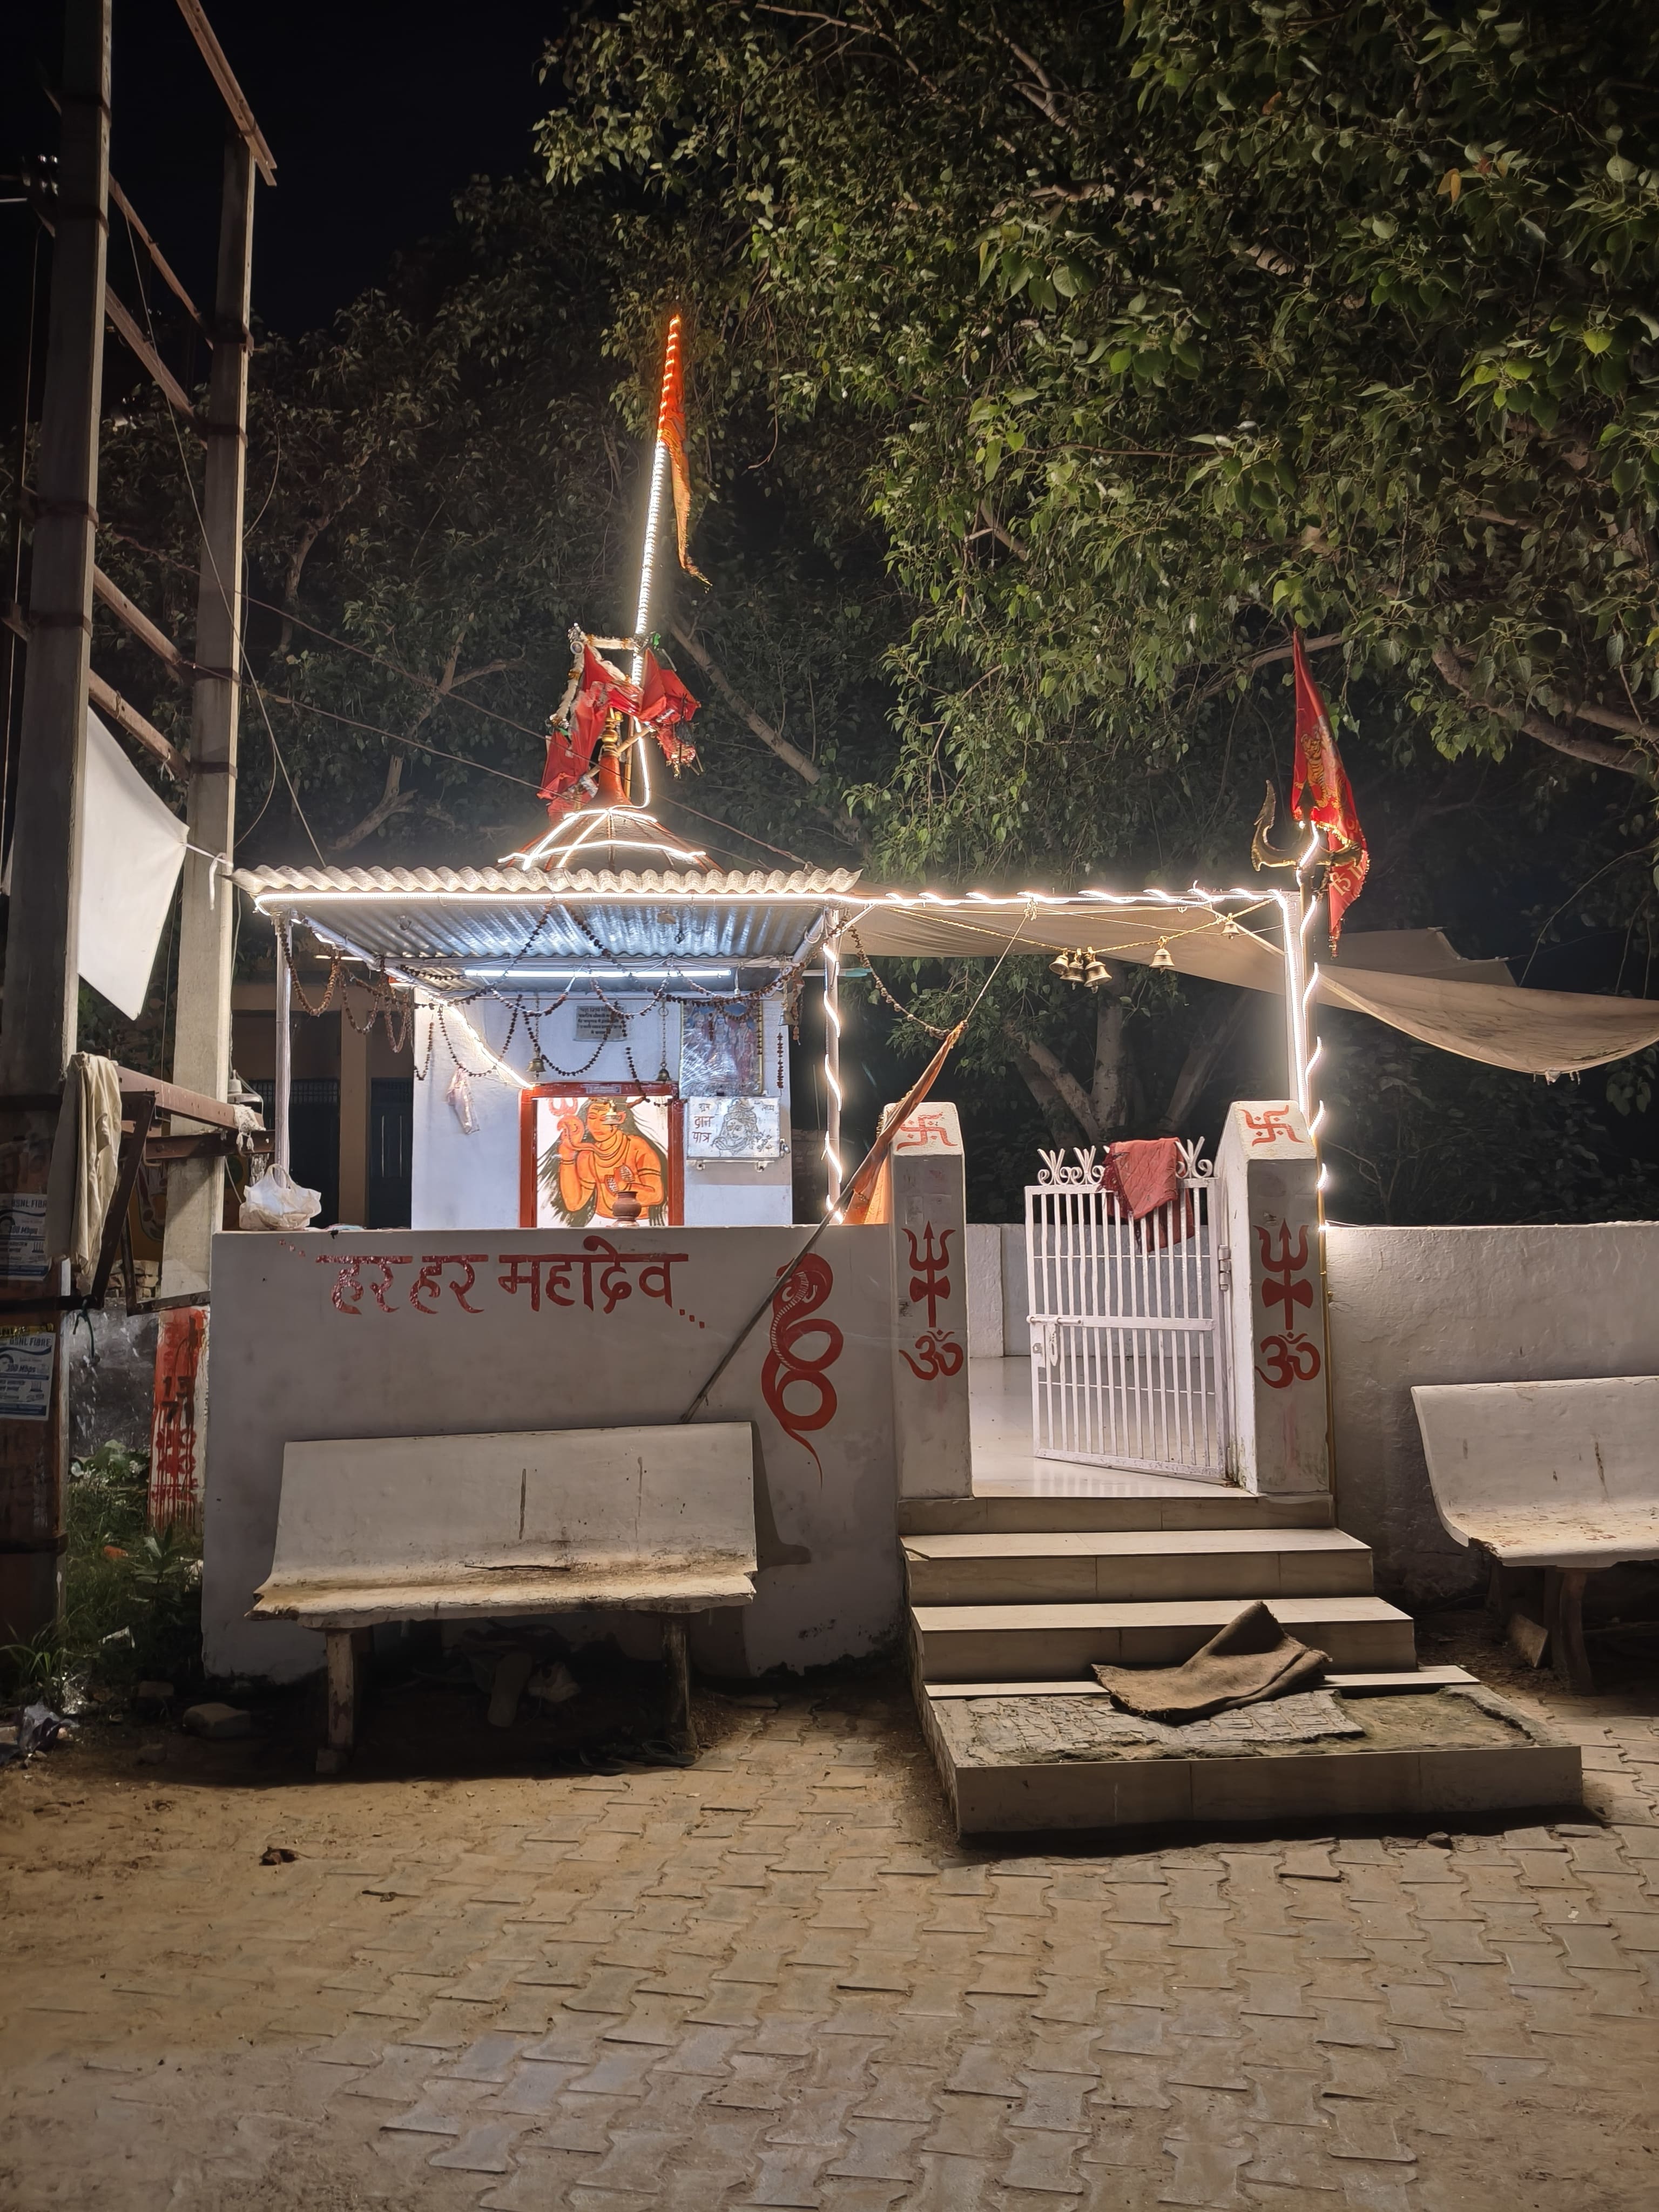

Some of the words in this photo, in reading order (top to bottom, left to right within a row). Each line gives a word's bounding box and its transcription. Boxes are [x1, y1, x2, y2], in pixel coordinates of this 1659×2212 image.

[694, 1116, 716, 1129] दान
[692, 1131, 712, 1144] पात्र
[315, 1254, 413, 1314] हर
[409, 1254, 489, 1314] हर
